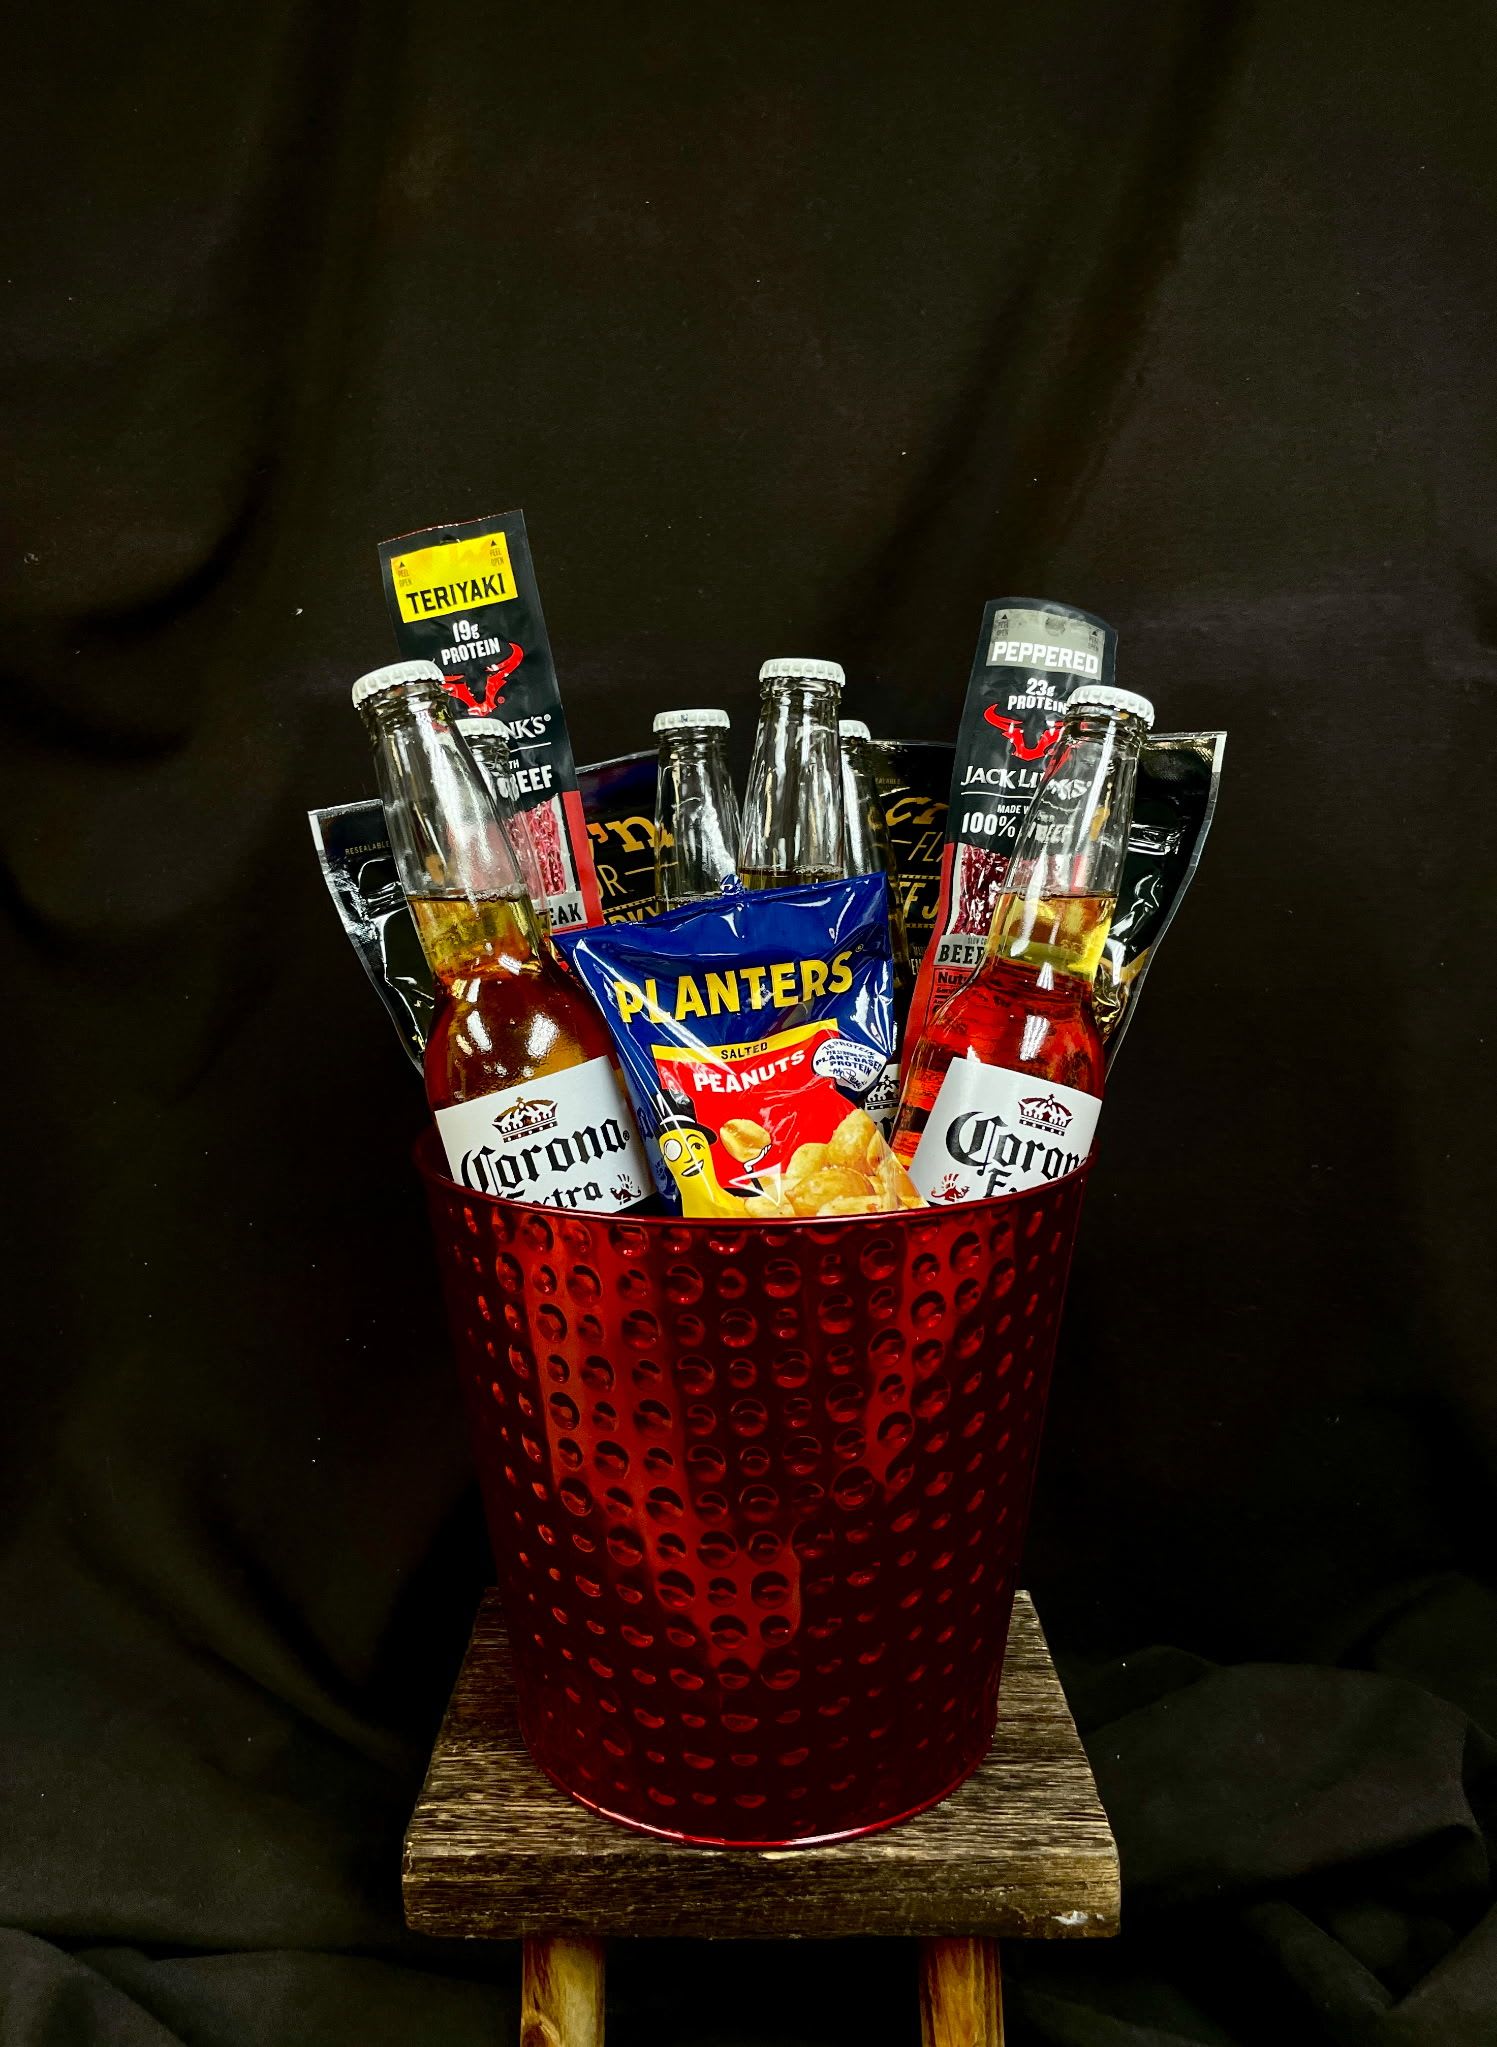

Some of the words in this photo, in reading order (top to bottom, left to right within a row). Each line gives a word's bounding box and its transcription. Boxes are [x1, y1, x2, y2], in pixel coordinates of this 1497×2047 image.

[406, 573, 506, 614] TERIYAKI
[452, 620, 480, 643] 19g
[441, 637, 500, 666] PROTEIN
[991, 641, 1098, 674] PEPPERED
[1025, 677, 1056, 697] 23g
[1007, 695, 1068, 715] PROTEIN
[512, 765, 552, 797] EEF
[960, 765, 1016, 789] JACK
[997, 804, 1021, 814] MADE
[961, 811, 1016, 838] 100%
[345, 841, 391, 855] RESEALABLE
[551, 903, 582, 926] EAK
[613, 951, 854, 1024] PLANTERS
[721, 1041, 768, 1060] SALTED
[833, 1041, 876, 1056] PROTEIN
[693, 1049, 805, 1093] PEANUTS
[815, 1054, 883, 1072] PLANT-BASED
[830, 1061, 872, 1077] PROTEIN
[461, 1118, 626, 1197] Corona
[946, 1111, 1087, 1181] Coron
